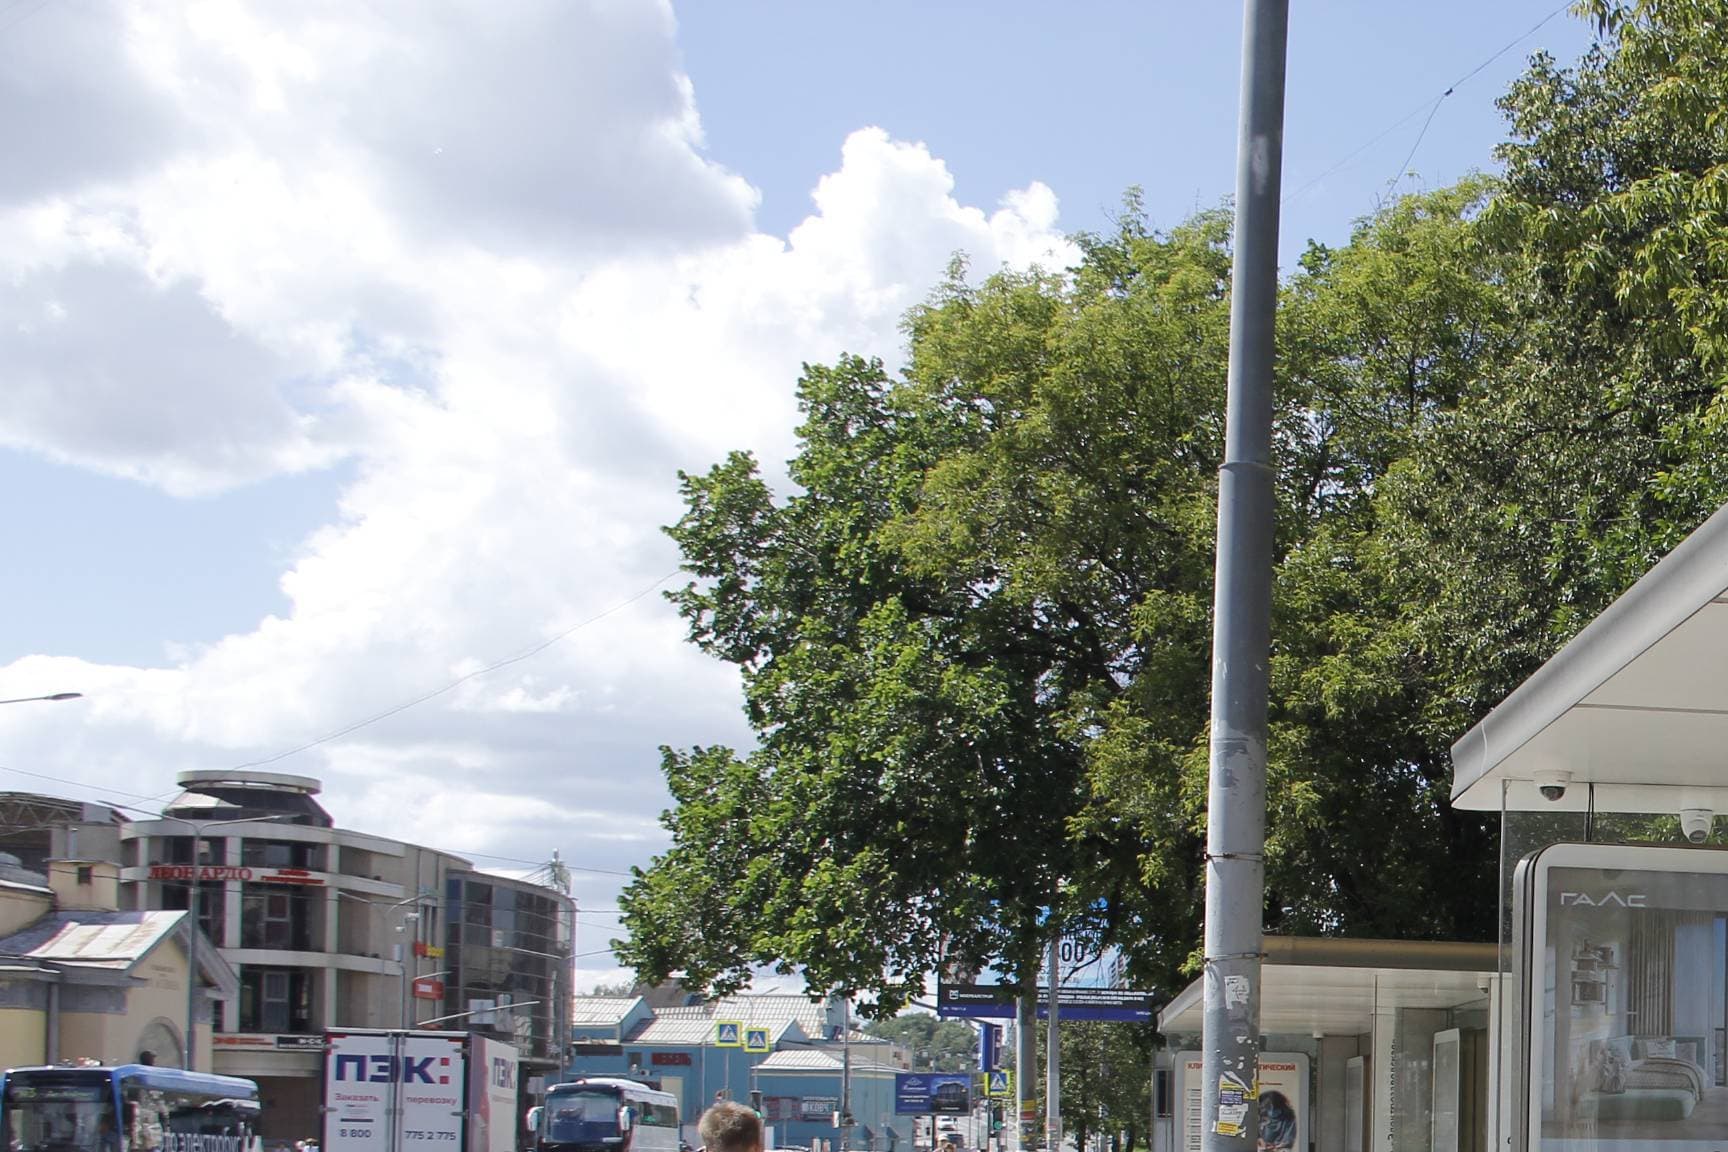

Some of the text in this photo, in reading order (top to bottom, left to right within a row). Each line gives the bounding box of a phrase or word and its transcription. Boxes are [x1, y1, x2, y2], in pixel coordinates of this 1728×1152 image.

[340, 1129, 457, 1140] 8 800 775 2 775
